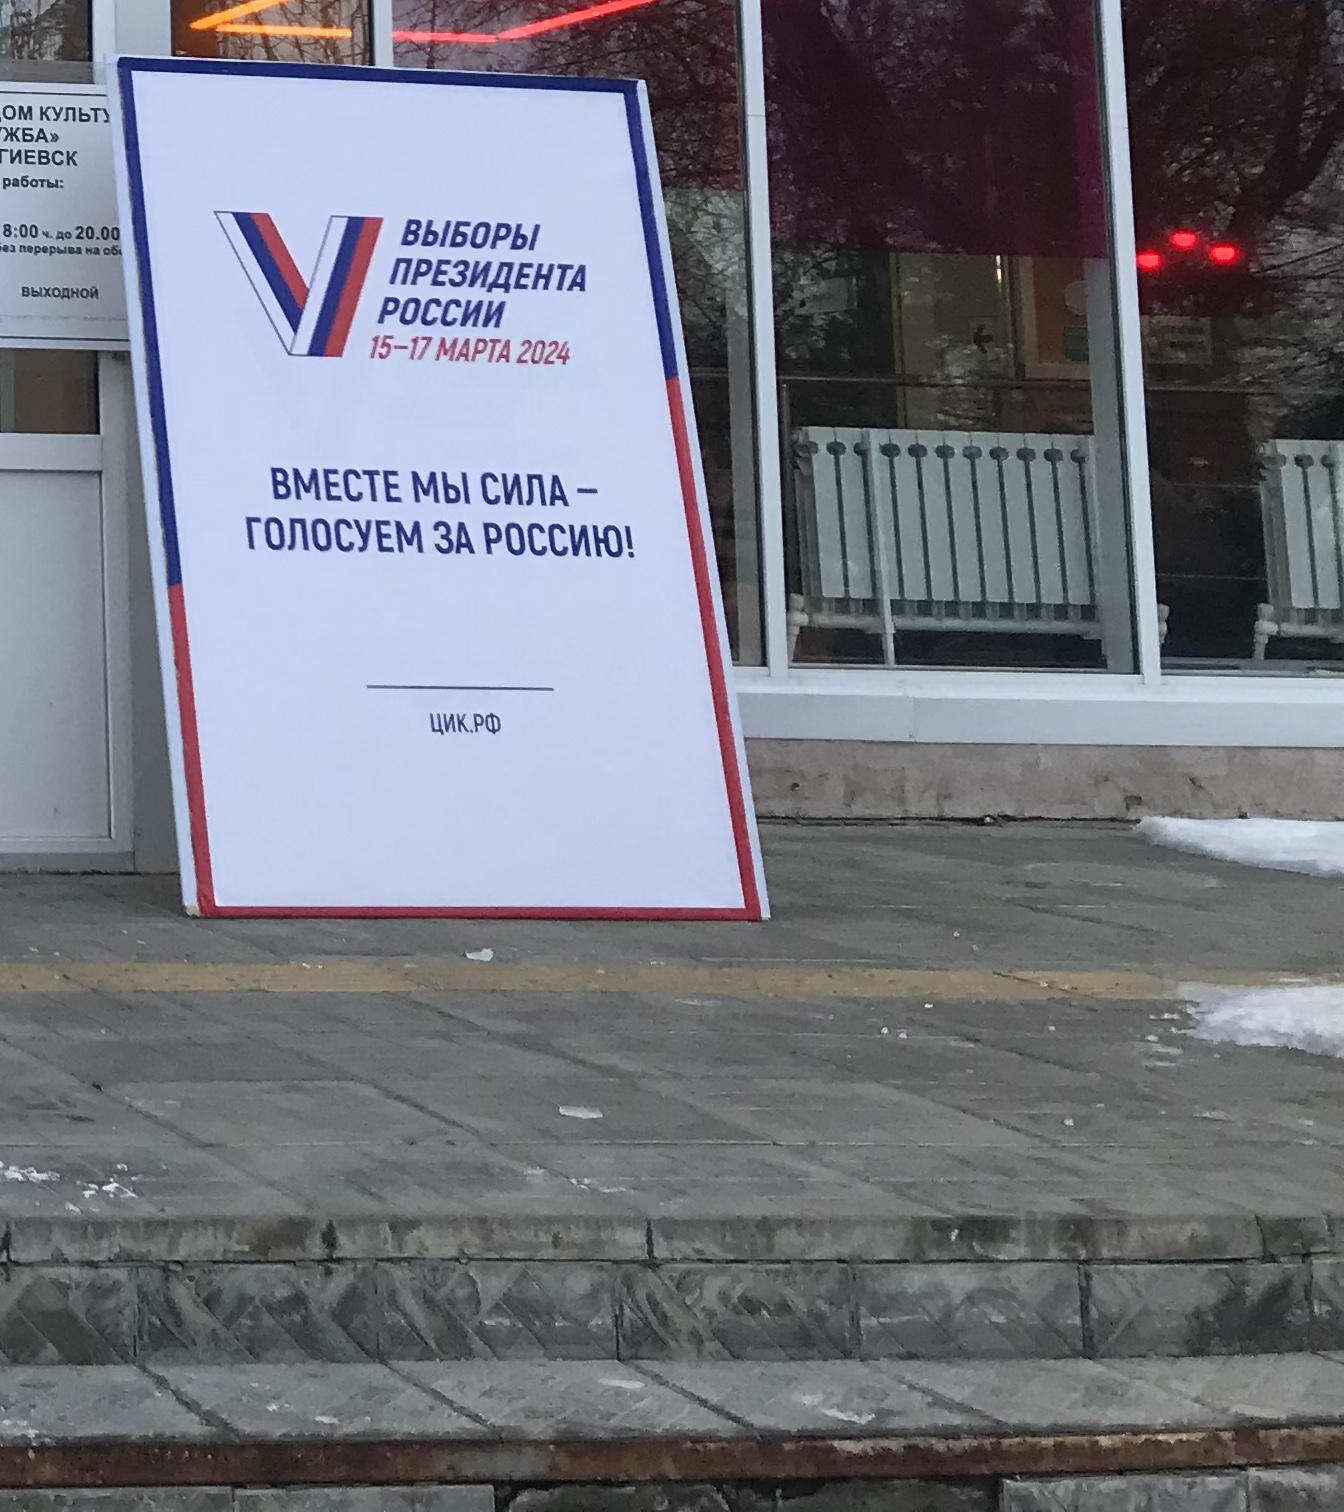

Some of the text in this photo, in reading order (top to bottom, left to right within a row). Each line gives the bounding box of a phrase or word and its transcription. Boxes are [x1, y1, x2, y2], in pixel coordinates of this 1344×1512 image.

[2, 175, 64, 190] работы:
[3, 224, 39, 238] 8:00
[56, 230, 72, 240] до
[75, 226, 120, 240] 20.00
[401, 219, 541, 253] ВЫБОРЫ
[19, 244, 82, 256] перерыва
[85, 247, 100, 255] на
[388, 258, 587, 293] ПРЕЗИДЕНТА
[21, 286, 99, 300] ВЫХОДНОЙ
[377, 296, 506, 329] РОССИИ
[434, 337, 513, 364] МАРТА
[516, 340, 571, 367] 2024
[270, 466, 403, 503] ВМЕСТЕ
[412, 469, 470, 505] МЫ
[480, 471, 570, 507] СИЛА
[245, 515, 636, 559] ГОЛОСУЕМ ЗА РОССИЮ!
[430, 713, 502, 736] ЦИК.РФ
